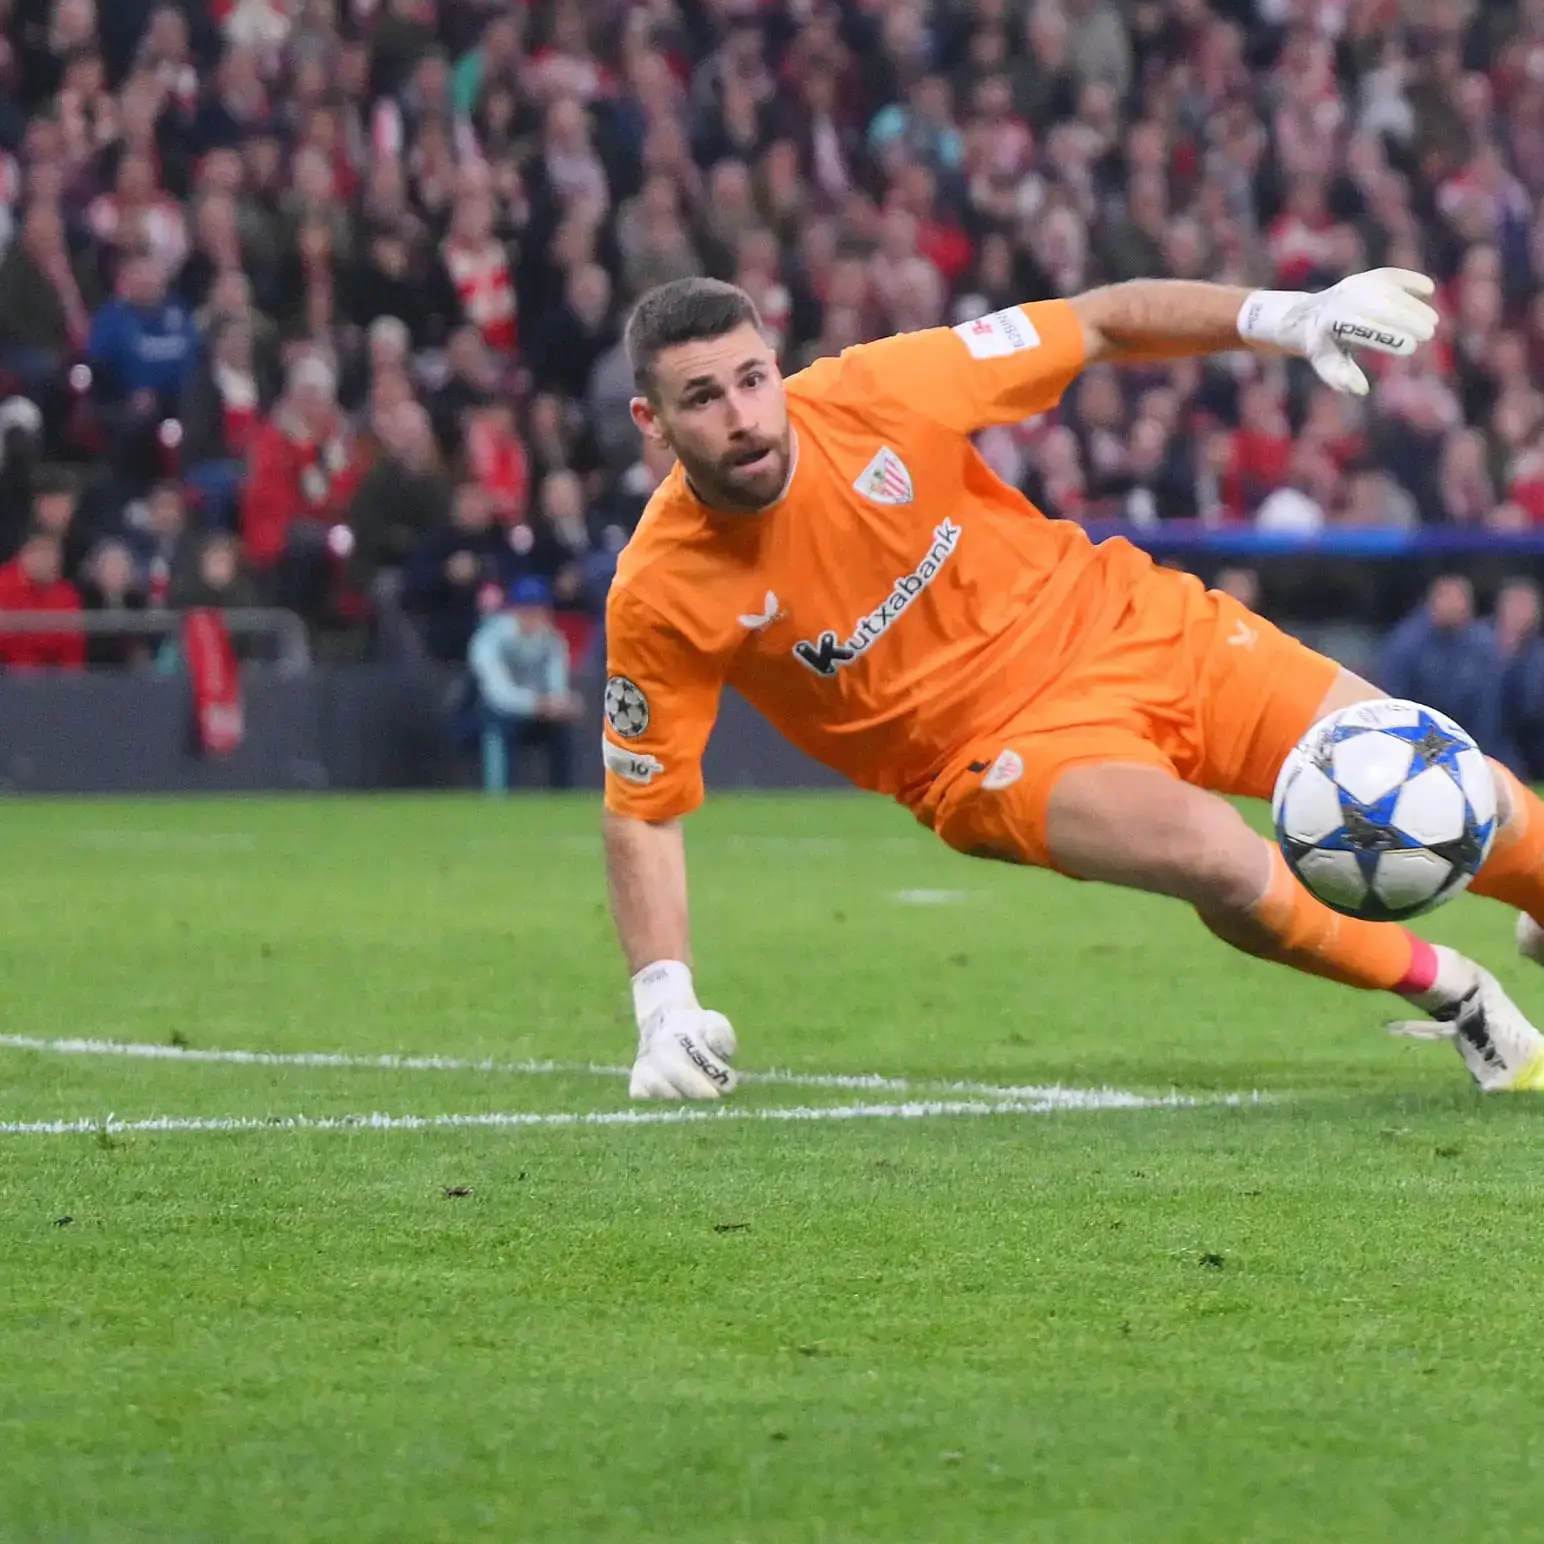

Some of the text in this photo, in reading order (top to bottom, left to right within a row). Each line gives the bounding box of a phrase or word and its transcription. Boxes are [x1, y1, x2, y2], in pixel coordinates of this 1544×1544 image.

[1332, 320, 1405, 348] reusch
[796, 519, 958, 674] Kutxabank
[674, 1032, 729, 1085] reusch
